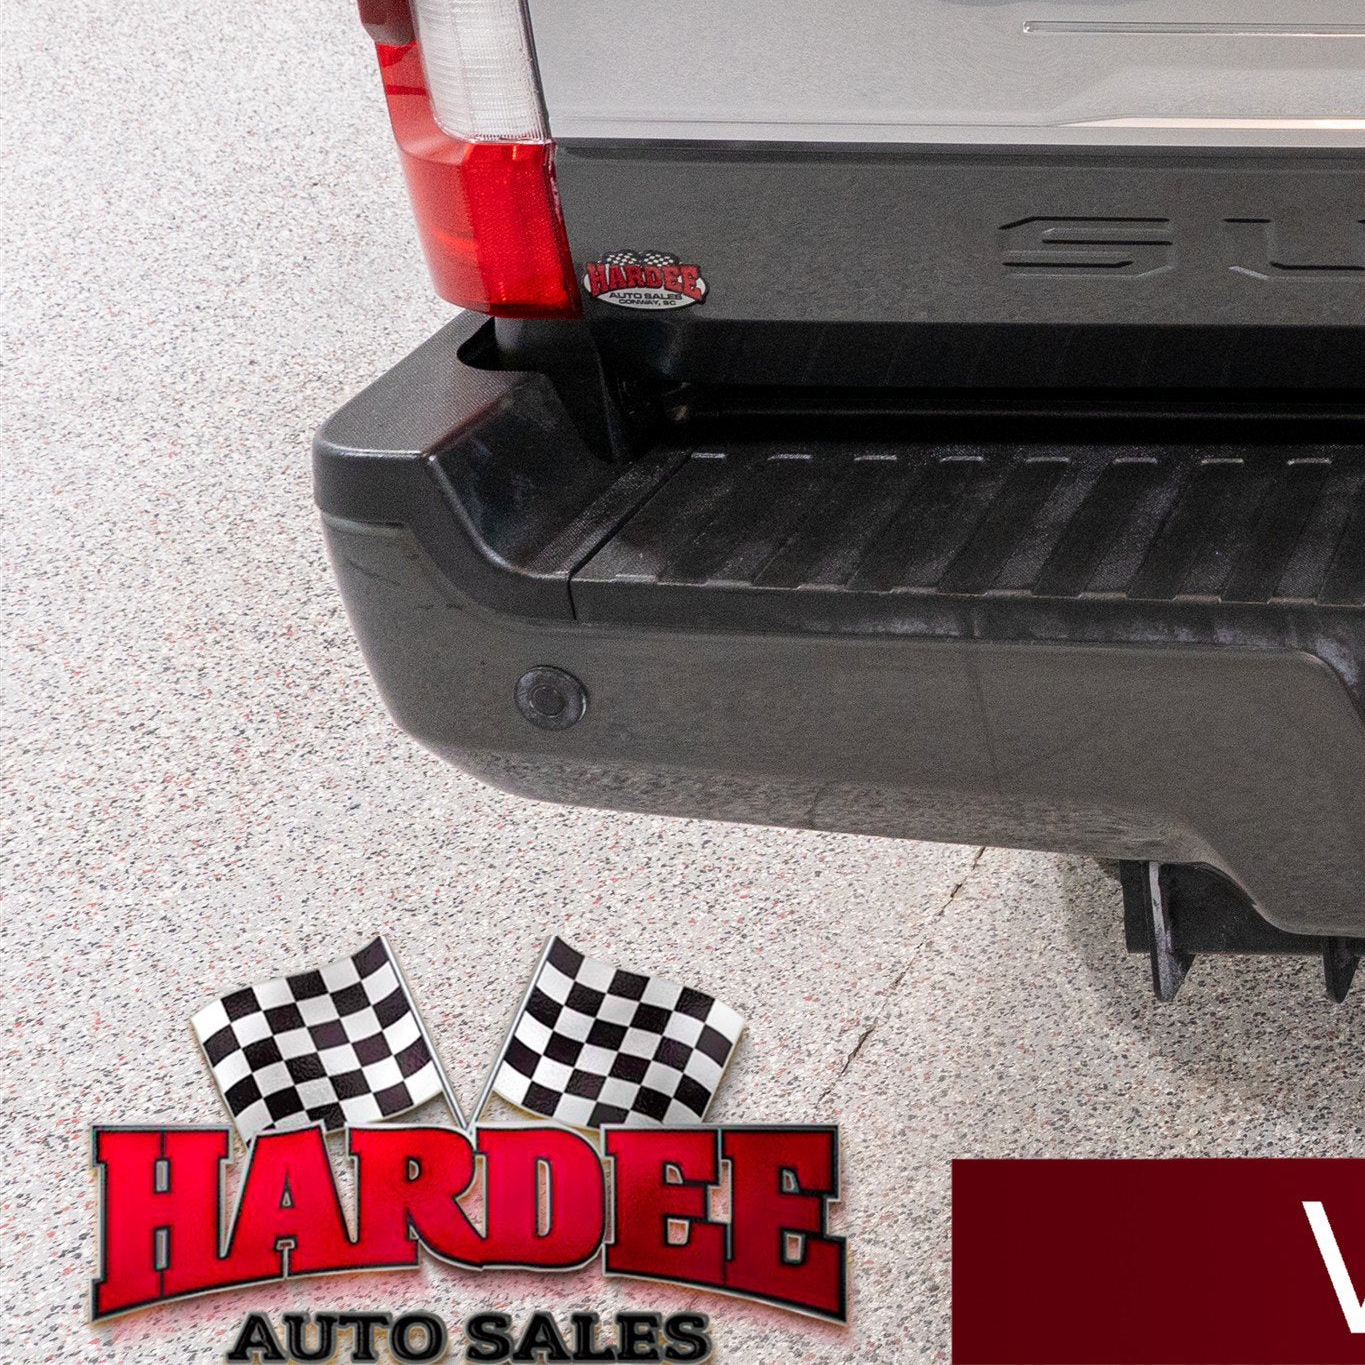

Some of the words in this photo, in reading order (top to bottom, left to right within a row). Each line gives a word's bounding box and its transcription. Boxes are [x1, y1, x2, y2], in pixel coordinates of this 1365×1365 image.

[586, 262, 704, 302] HARDEE
[609, 291, 643, 300] AUTO
[644, 291, 683, 301] SALES
